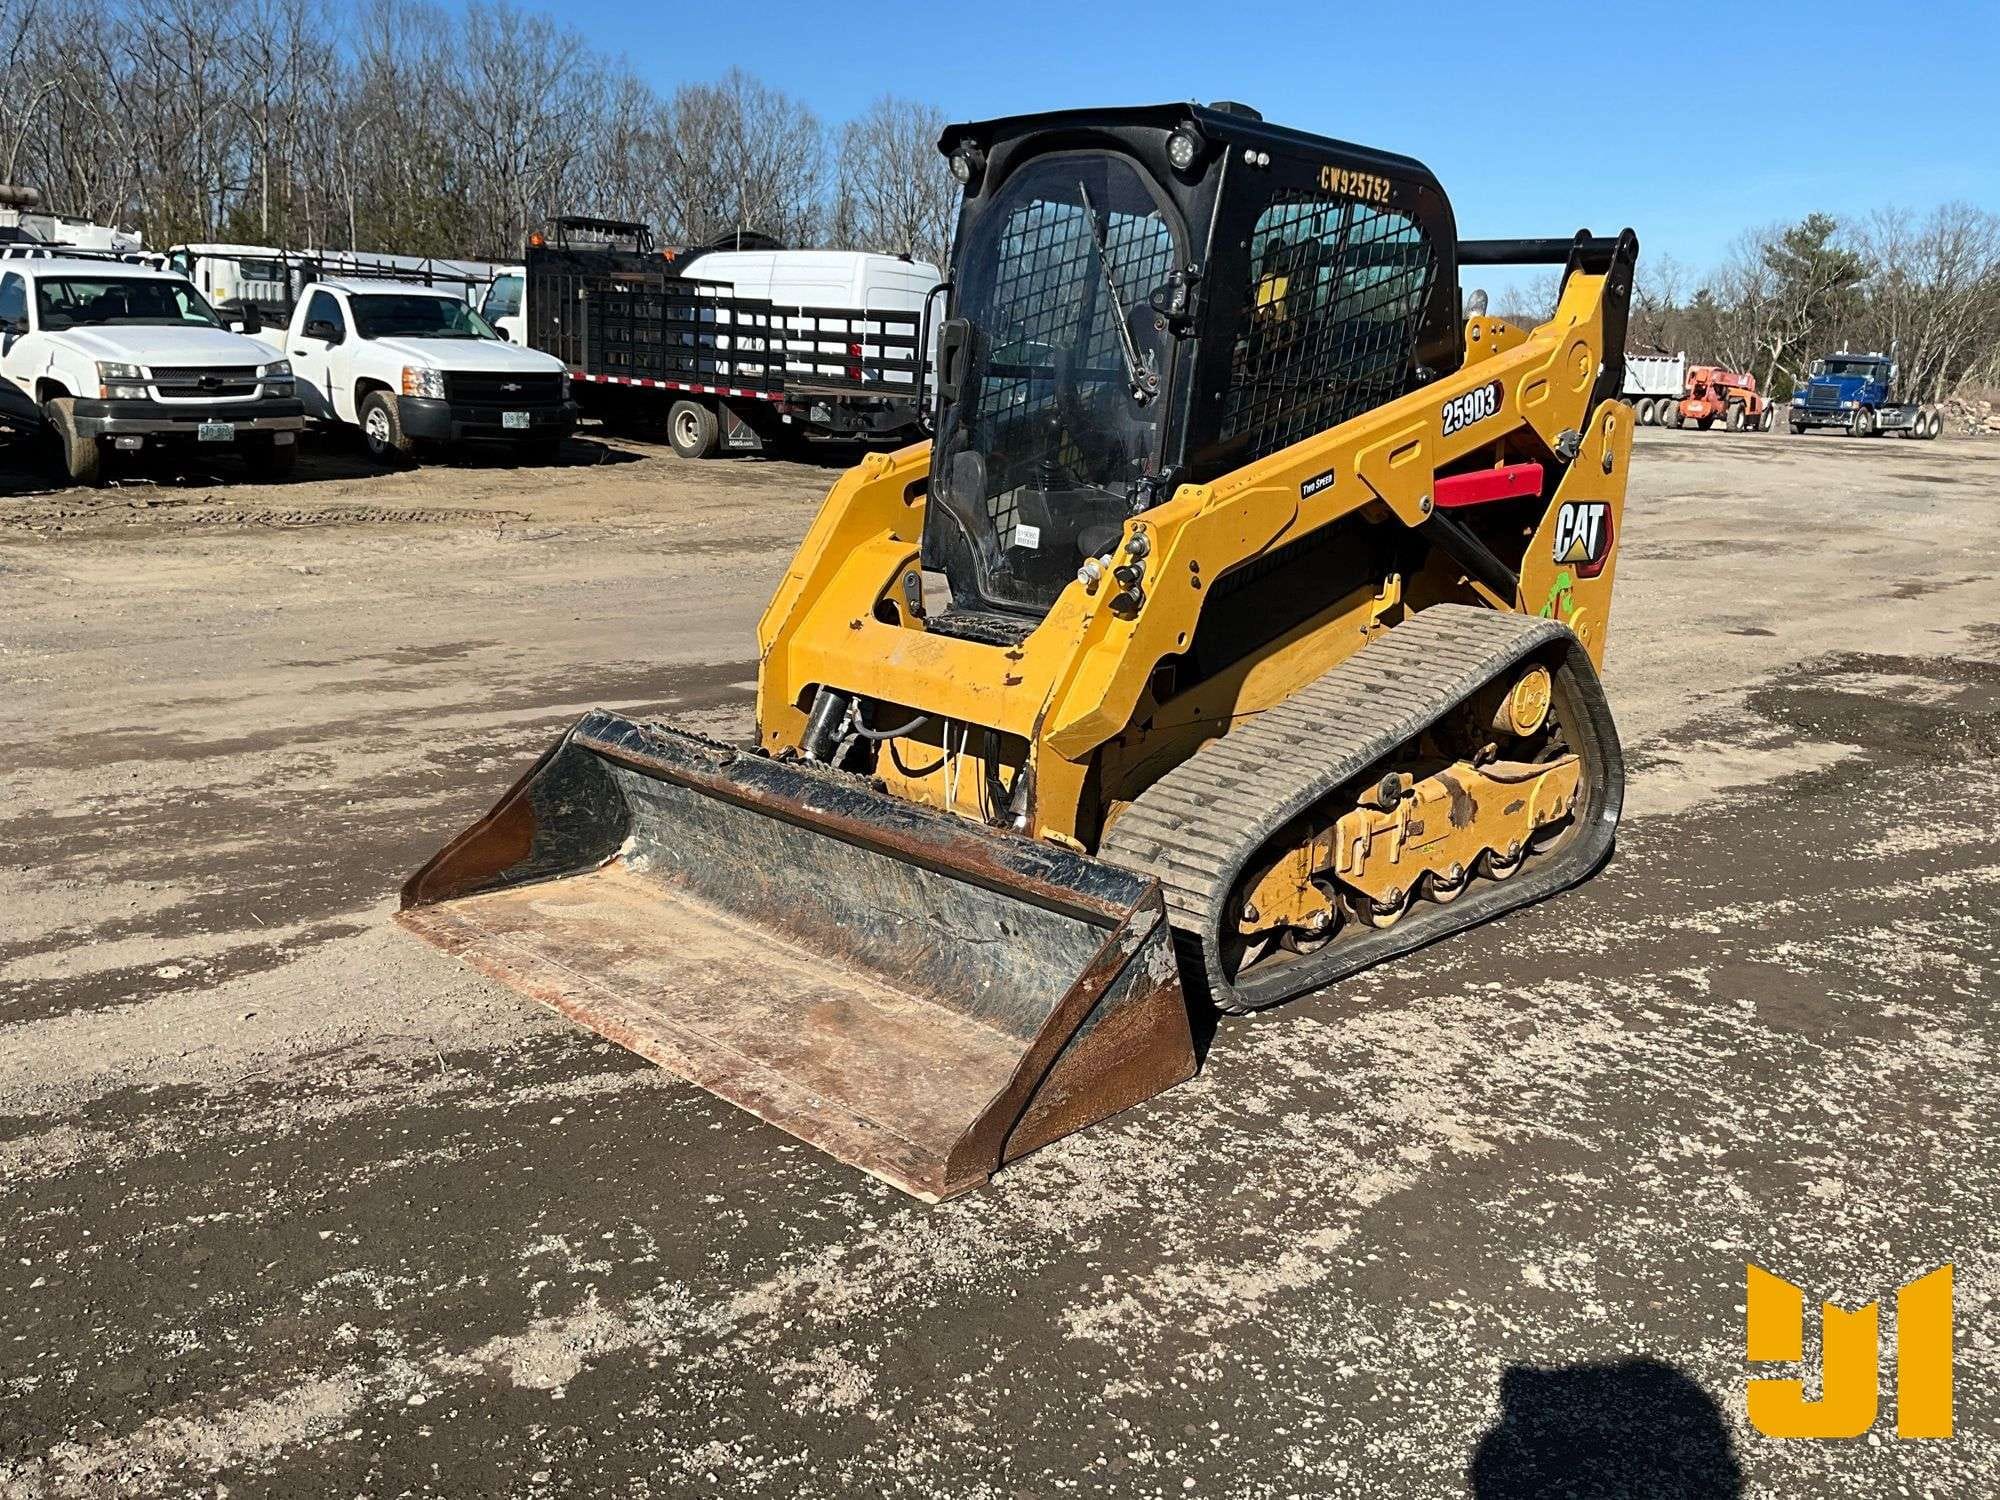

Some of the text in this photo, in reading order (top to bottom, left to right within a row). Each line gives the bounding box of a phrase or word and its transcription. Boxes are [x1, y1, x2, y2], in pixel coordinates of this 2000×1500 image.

[1321, 165, 1390, 203] CW925752
[1442, 383, 1495, 436] 259D3
[1555, 503, 1605, 562] CAT
